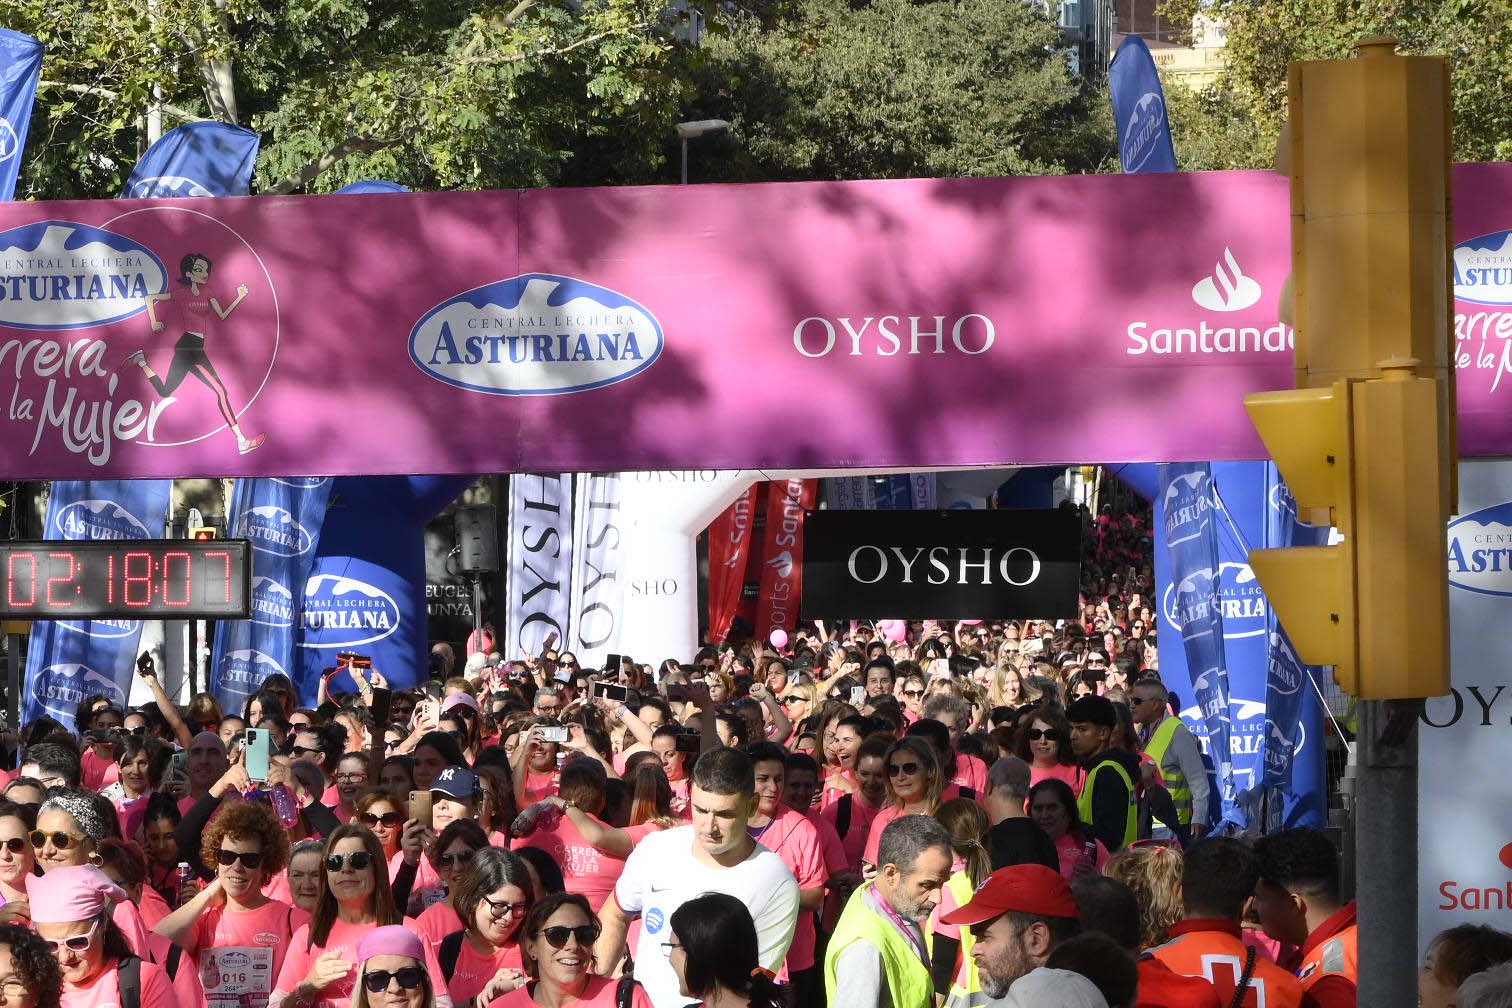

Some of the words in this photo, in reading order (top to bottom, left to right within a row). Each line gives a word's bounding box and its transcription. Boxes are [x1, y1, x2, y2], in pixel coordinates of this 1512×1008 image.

[71, 256, 143, 269] LECHERA
[428, 321, 645, 367] ASTURIANA
[468, 318, 548, 331] CENTRAL
[554, 315, 636, 328] LECHERA
[792, 313, 997, 358] OYSHO
[1476, 340, 1495, 369] la
[9, 379, 33, 421] la
[29, 373, 178, 467] Mujer
[8, 552, 231, 607] 02:18:07
[847, 545, 1042, 587] OYSHO
[337, 599, 386, 608] LECHERA
[1418, 686, 1512, 729] OY
[222, 972, 246, 983] 016
